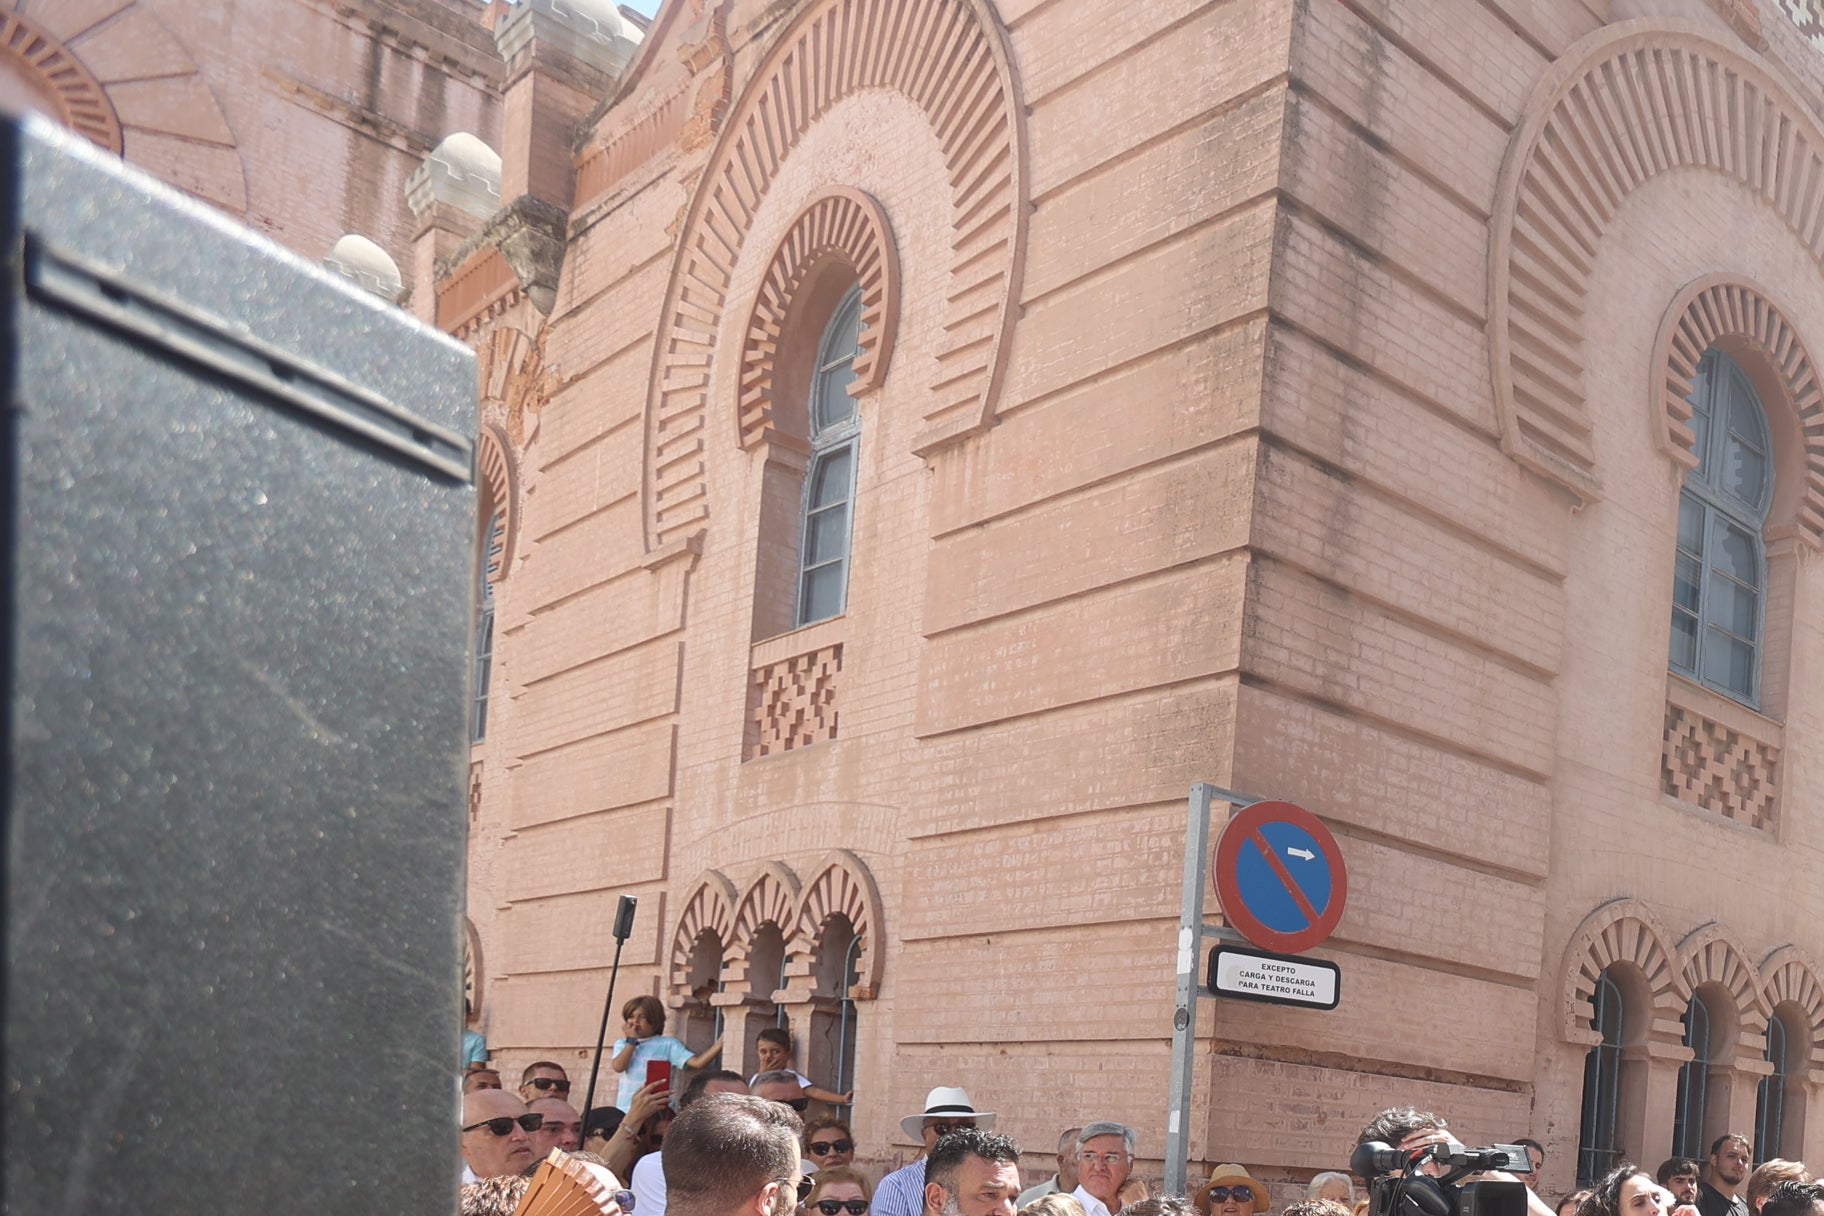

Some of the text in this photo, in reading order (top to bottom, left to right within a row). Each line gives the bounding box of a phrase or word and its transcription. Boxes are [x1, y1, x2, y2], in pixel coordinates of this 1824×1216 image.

[1261, 963, 1296, 974] EXCEPTO
[1239, 970, 1266, 980] CARGA
[1275, 975, 1316, 987] DESCARGA
[1238, 981, 1315, 997] PARA TEATRO FALLA
